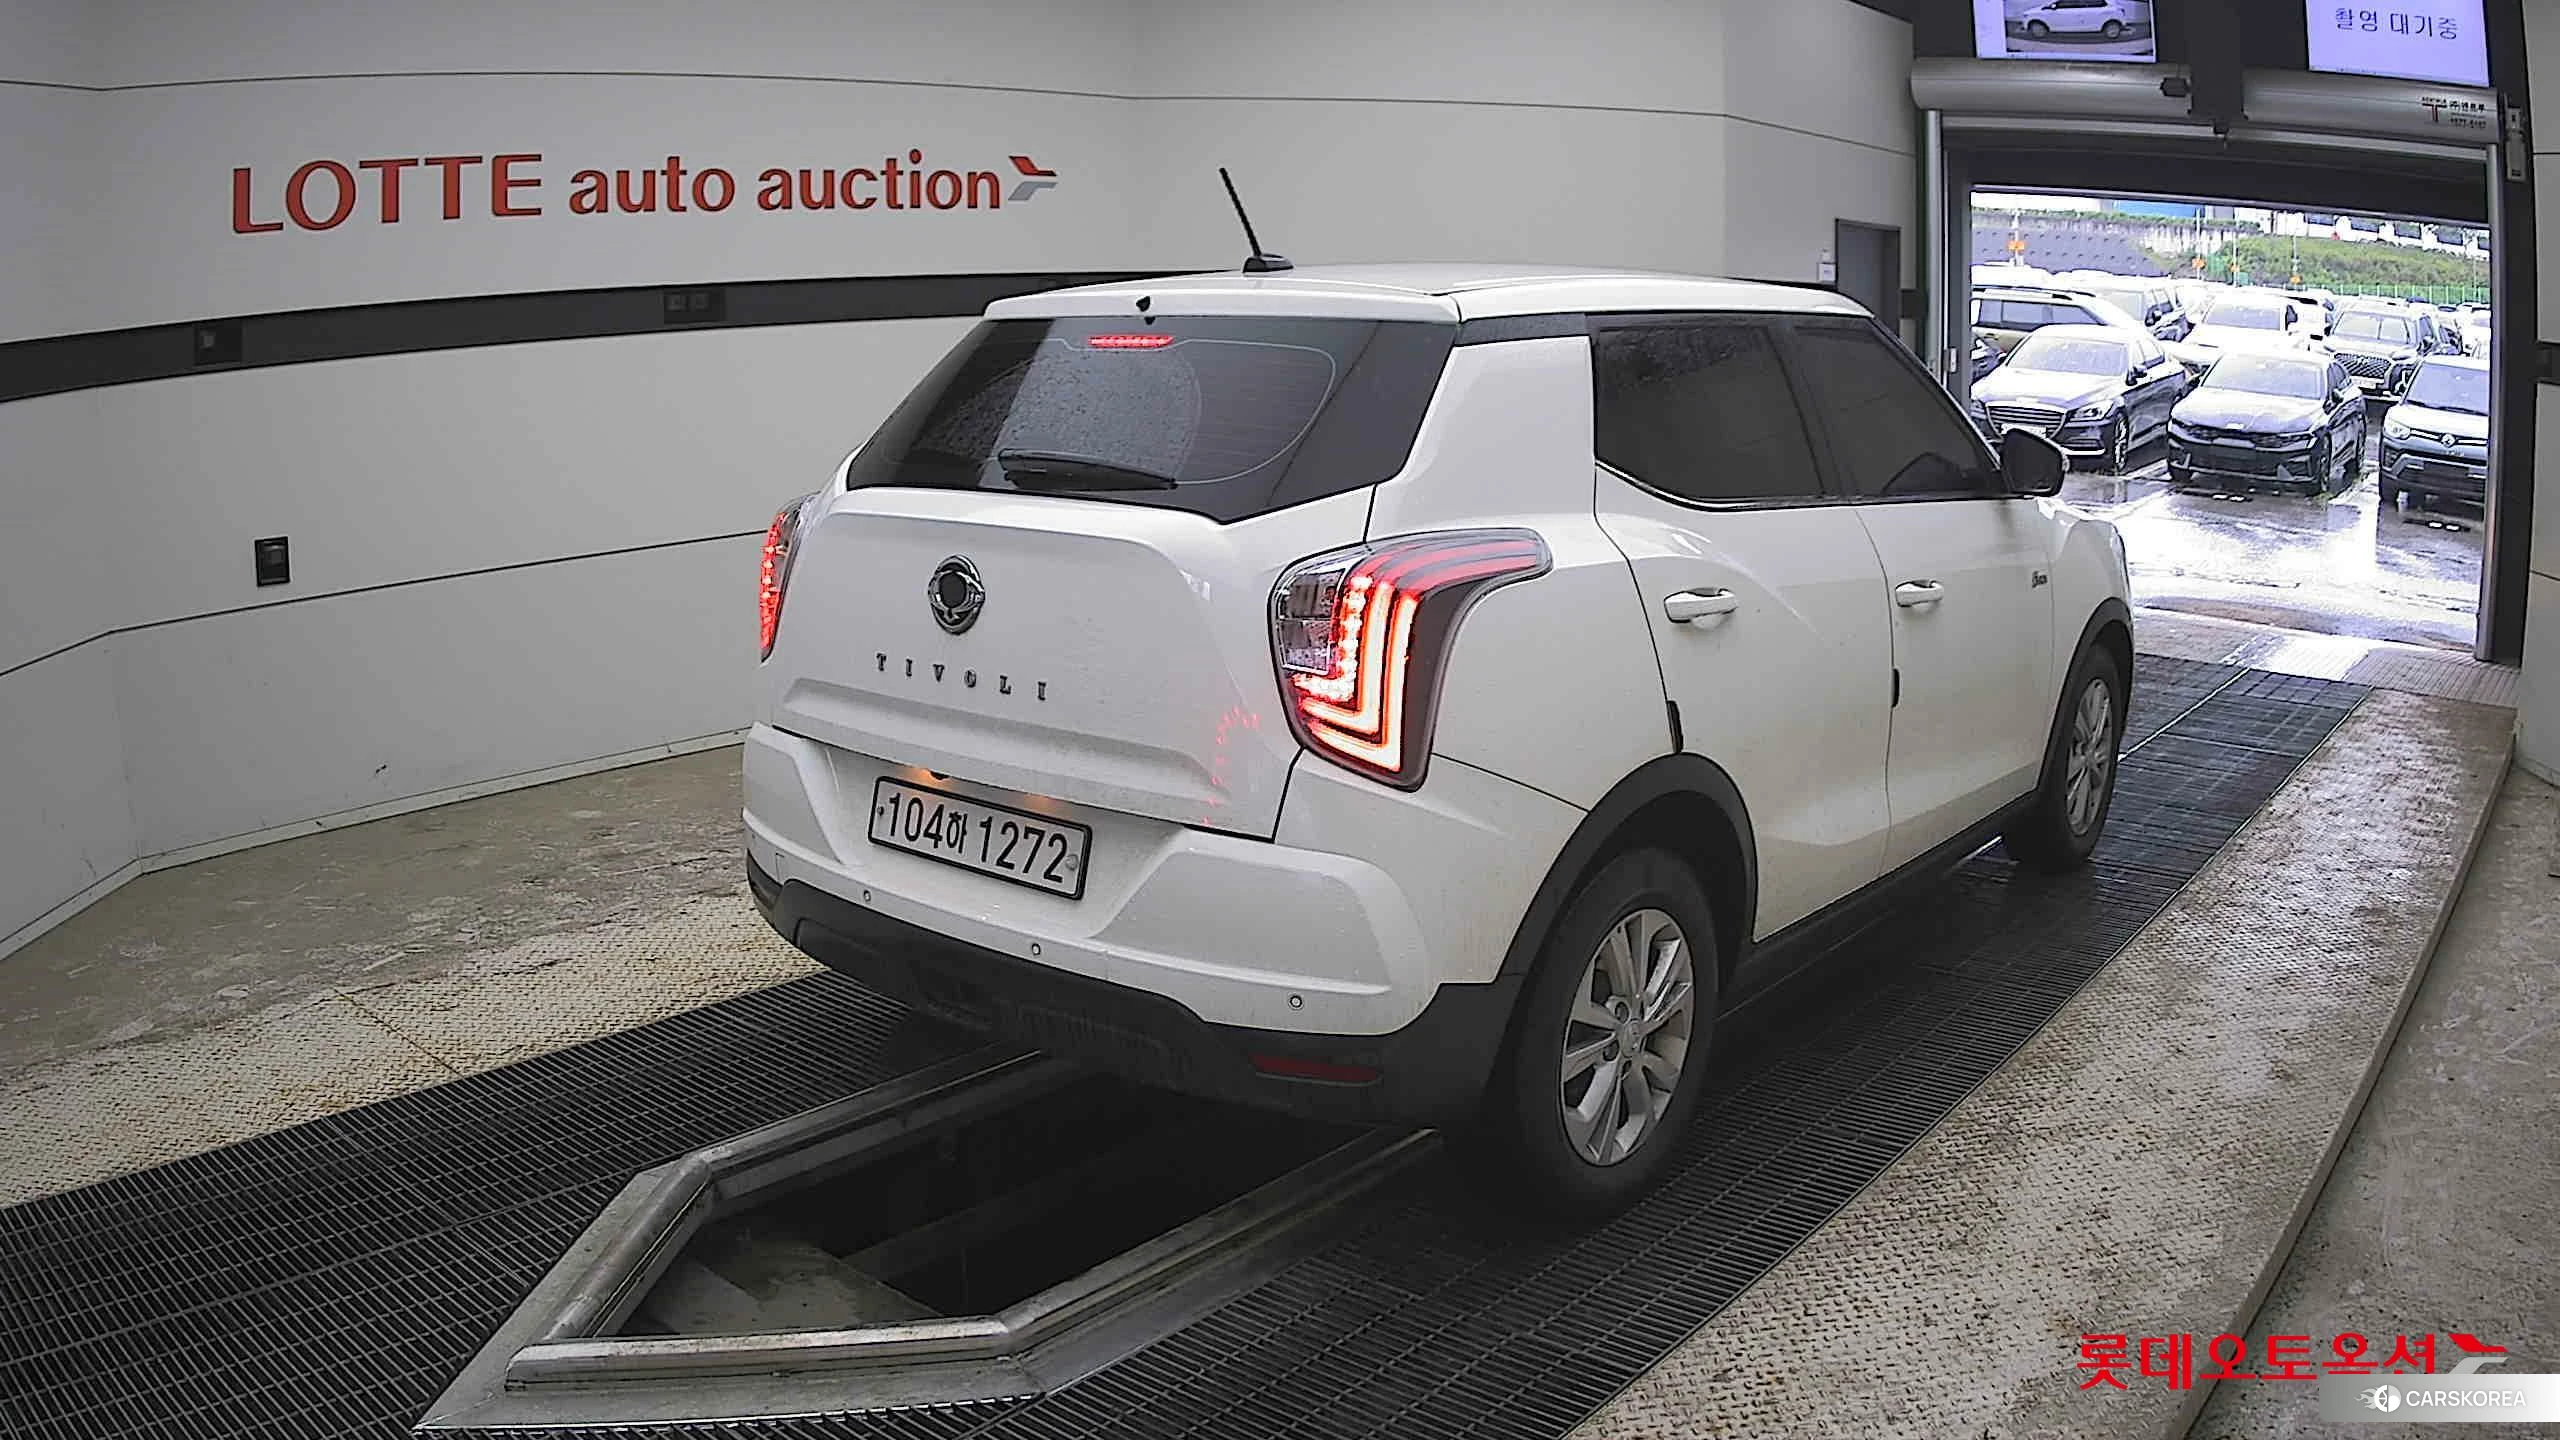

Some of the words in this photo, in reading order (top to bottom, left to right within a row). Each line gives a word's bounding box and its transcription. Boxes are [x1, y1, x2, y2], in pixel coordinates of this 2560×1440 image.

[2336, 8, 2378, 32] 촬영
[2390, 13, 2457, 40] 대기중
[232, 153, 542, 234] LOTTE
[569, 155, 735, 214] auto
[757, 149, 1001, 211] auction
[876, 652, 1048, 701] TIVOLI
[888, 791, 968, 854] 104하
[979, 816, 1069, 884] 1272
